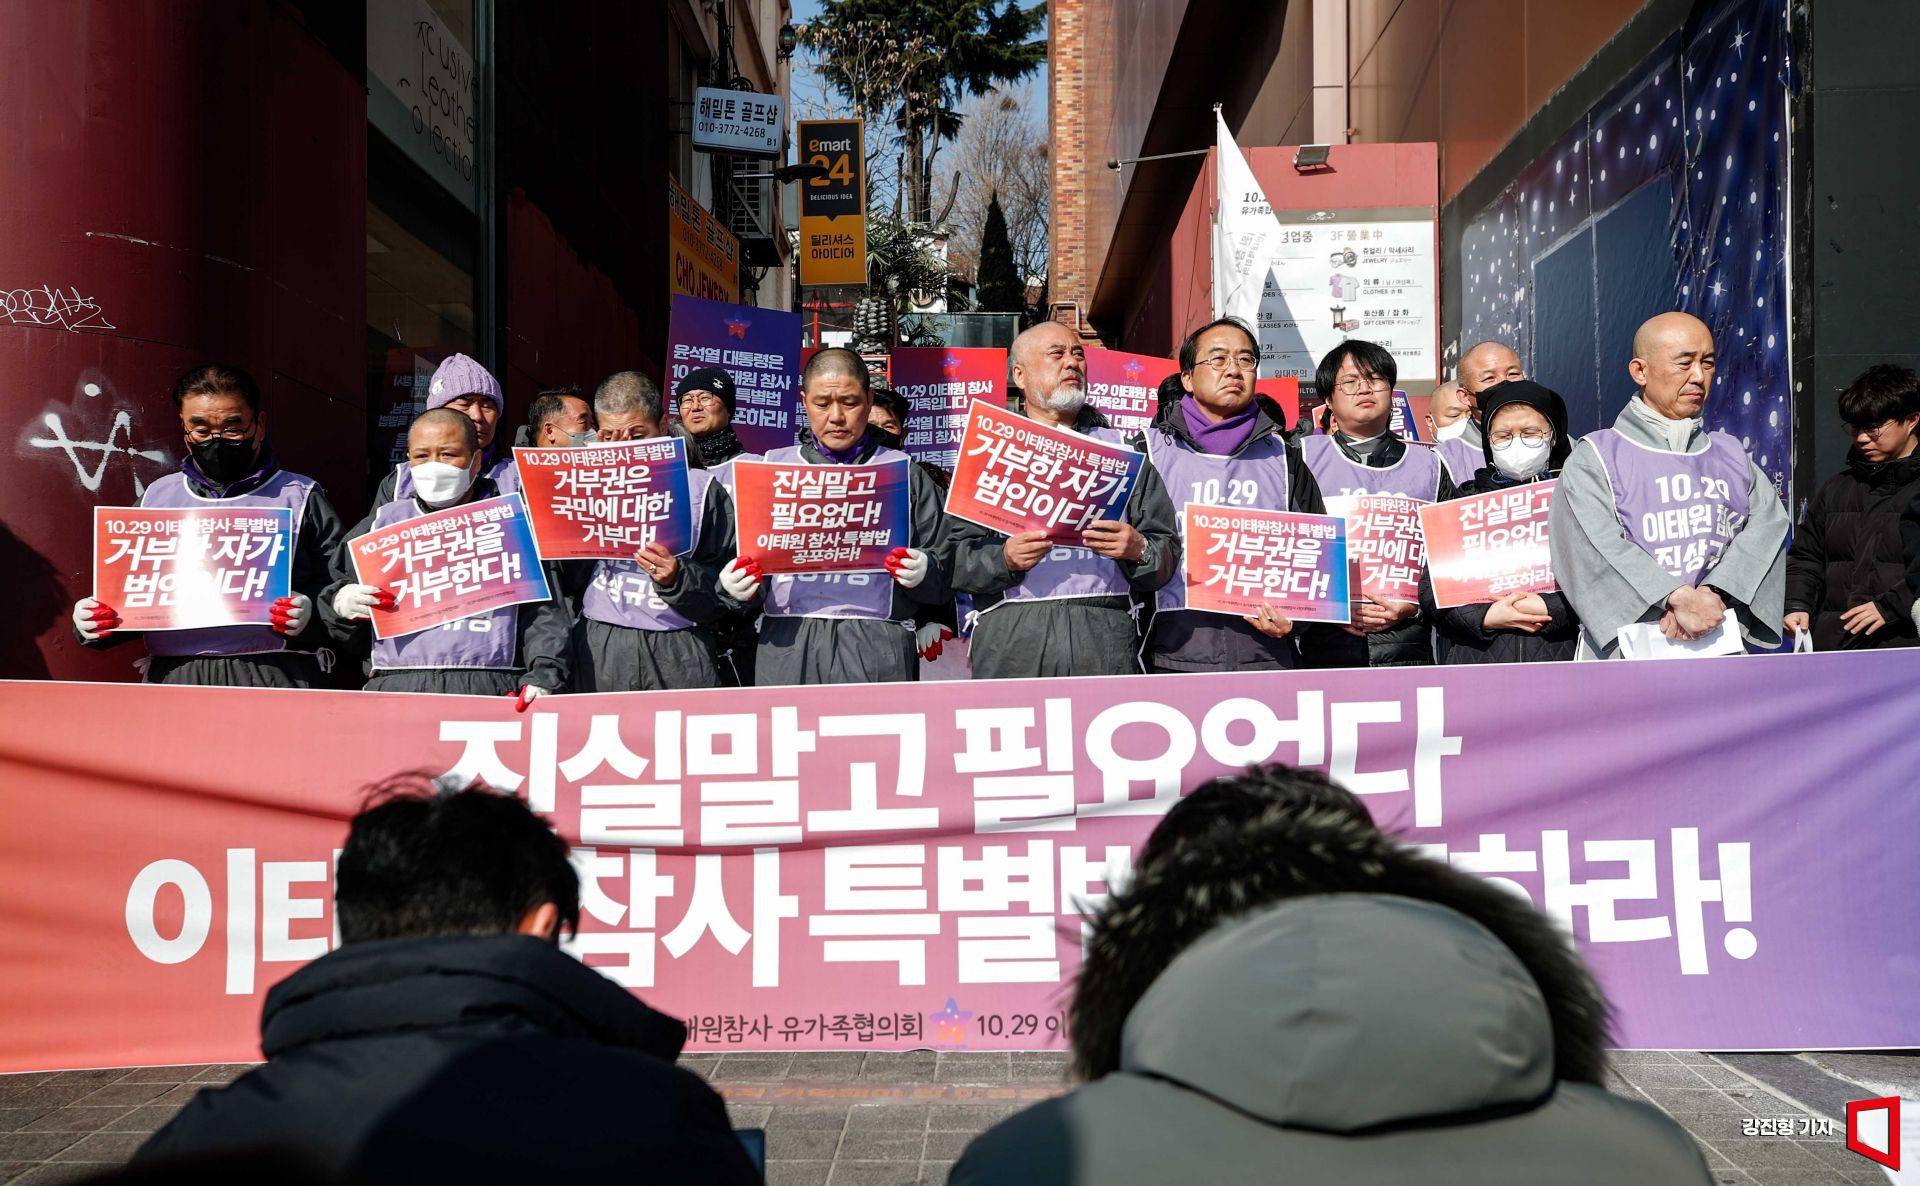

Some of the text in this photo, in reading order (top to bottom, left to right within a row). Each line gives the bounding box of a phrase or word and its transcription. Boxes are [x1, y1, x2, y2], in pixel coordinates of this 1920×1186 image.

[700, 98, 778, 125] 해밀톤 골프샵
[699, 122, 766, 138] 010-3772-4268
[767, 138, 777, 147] B1
[809, 139, 851, 152] emart
[809, 154, 854, 187] 24
[669, 183, 733, 264] 해밀톤 골프샵
[1330, 230, 1344, 240] 3F
[811, 234, 854, 247] 딜리셔스
[811, 247, 855, 259] 아이디어
[676, 251, 695, 296] CHO
[673, 344, 784, 370] 윤석열 대통령은
[724, 369, 757, 388] 태원
[760, 373, 791, 390] 참사
[895, 380, 993, 397] 10.29 이태원 참사
[1111, 385, 1146, 399] 이태원
[735, 388, 782, 407] 특별법
[907, 395, 968, 411] 가족입니다
[1086, 395, 1148, 412] 가족입니다
[731, 407, 788, 429] 포하라!
[523, 442, 676, 467] 10.29 이태원참사 특별법
[976, 415, 1130, 475] 10.29 이태원참사 특별법
[554, 464, 652, 496] 거부권은
[967, 433, 1129, 506] 거부한 자가
[773, 470, 876, 499] 진실말고
[1191, 479, 1258, 505] 10.29
[1655, 474, 1730, 503] 10.29
[551, 490, 673, 523] 국민에 대한
[770, 501, 882, 530] 필요없다!
[974, 471, 1106, 532] 범인이다!
[1459, 487, 1555, 531] 진실말고
[105, 517, 279, 535] 10.29 이태참사 특별법
[359, 504, 515, 555] 10.29 이태원참사 특별법
[1192, 515, 1336, 539] 10.29 이태원참사 특별법
[1643, 504, 1712, 542] 이태원
[212, 533, 285, 567] 자가
[381, 522, 505, 574] 거부권을
[757, 529, 891, 550] 이태원 참사 특별법
[1206, 532, 1322, 569] 거부권을
[792, 547, 861, 565] 공포하라!
[389, 552, 522, 609] 거부한다!
[1205, 564, 1330, 600] 거부한다!
[431, 706, 939, 847] 진실말고
[125, 848, 344, 994] 이태
[1395, 827, 1757, 975] 하라!
[777, 1012, 923, 1042] 유가족협의회
[977, 1014, 1038, 1039] 10.29
